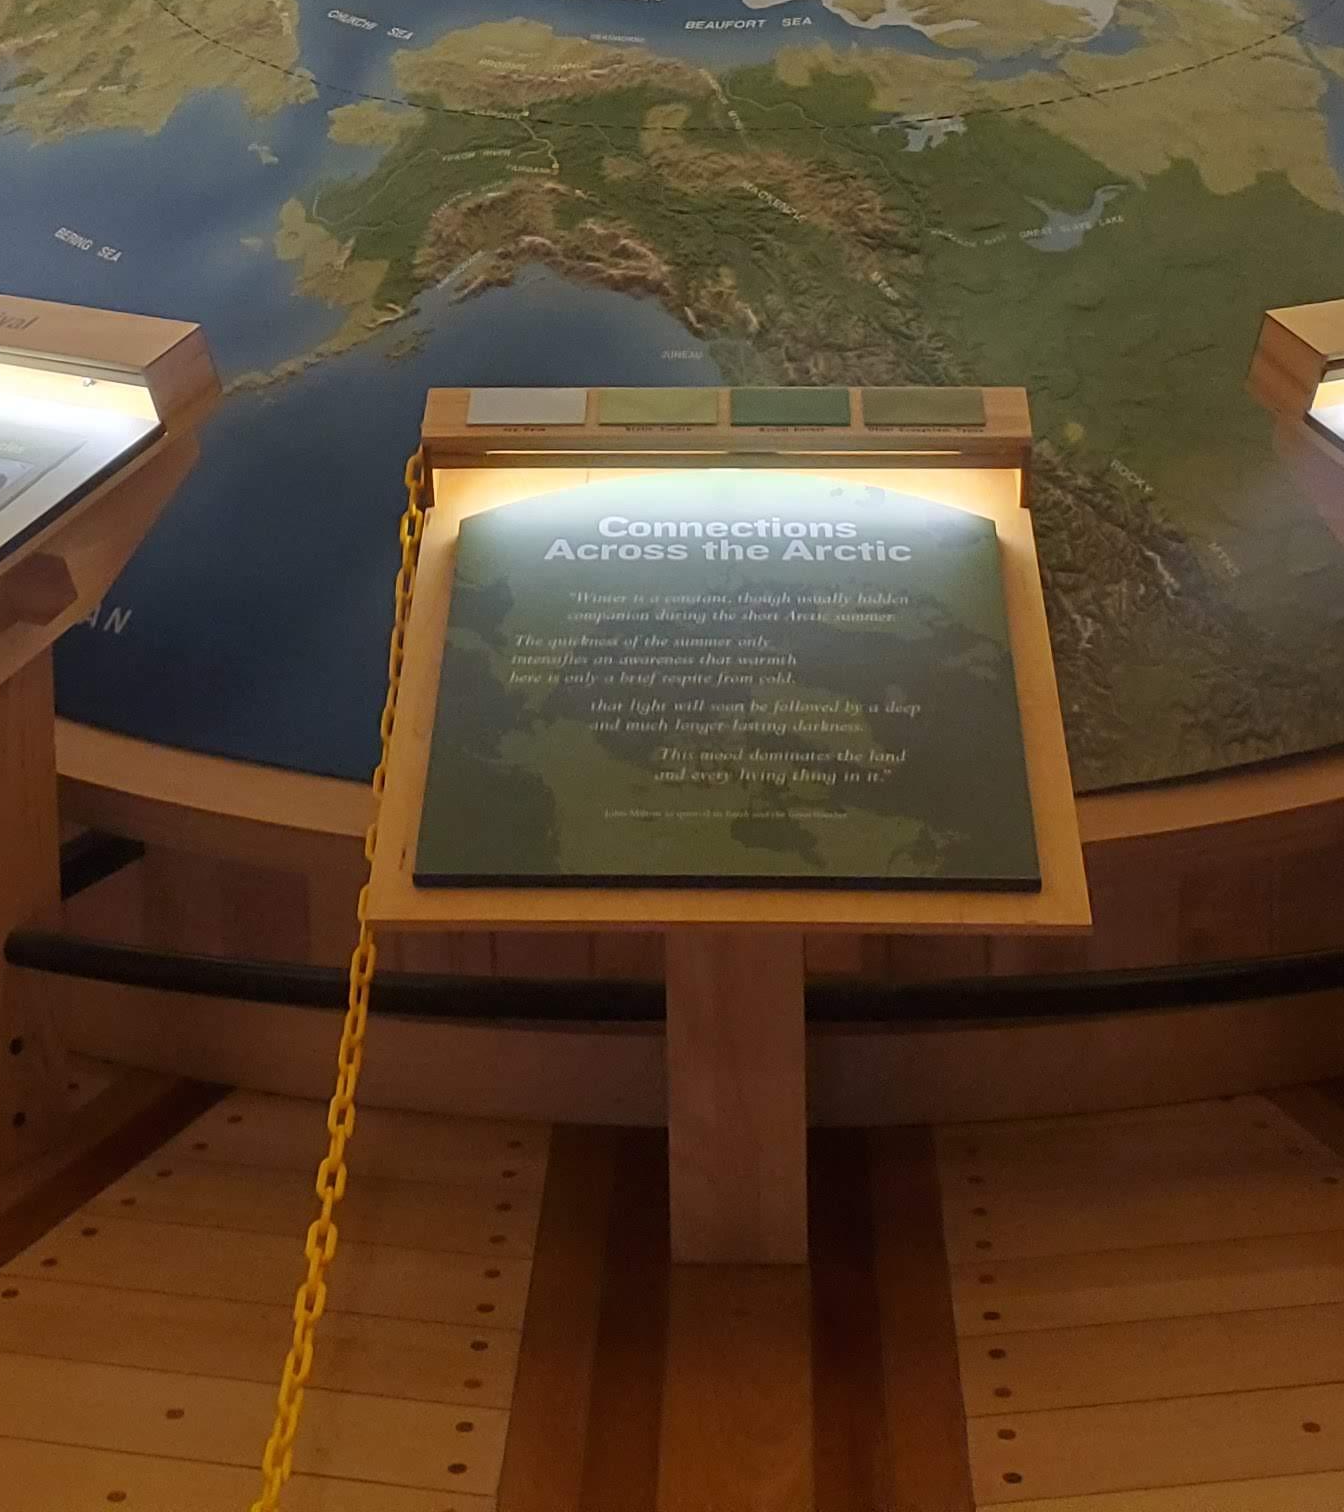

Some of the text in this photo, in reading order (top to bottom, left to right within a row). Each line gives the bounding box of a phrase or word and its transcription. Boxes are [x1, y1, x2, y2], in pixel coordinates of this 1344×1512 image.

[685, 17, 813, 29] BEAUFORT SEA
[387, 27, 414, 39] SEA
[55, 227, 123, 262] BERING SEA
[1111, 459, 1153, 494] ROCKY
[598, 516, 857, 538] Connections
[544, 539, 912, 561] Across the Arctic
[634, 592, 645, 603] is
[650, 595, 659, 603] a
[664, 593, 732, 604] constant,
[738, 592, 790, 607] though
[797, 592, 851, 607] usually
[857, 593, 909, 604] hidden
[568, 611, 649, 624] companion
[656, 610, 706, 624] during
[713, 610, 736, 621] the
[742, 610, 778, 621] short
[785, 610, 827, 621] Arctic
[516, 636, 542, 646] The
[548, 636, 619, 649] quickness
[624, 636, 641, 649] of
[645, 636, 668, 647] the
[673, 638, 732, 647] summer
[512, 653, 797, 668] intensifies an awareness that warmth
[510, 671, 796, 686] here is only a brief respite from cold.
[591, 698, 921, 718] that light will soon be followed by a deep
[590, 718, 620, 731] and
[626, 718, 668, 731] much
[792, 719, 864, 732] darkness.
[661, 748, 906, 762] This mood dominates the land
[655, 767, 686, 781] and
[691, 770, 730, 784] every
[740, 768, 786, 785] living
[792, 768, 837, 785] thing
[844, 770, 860, 782] in
